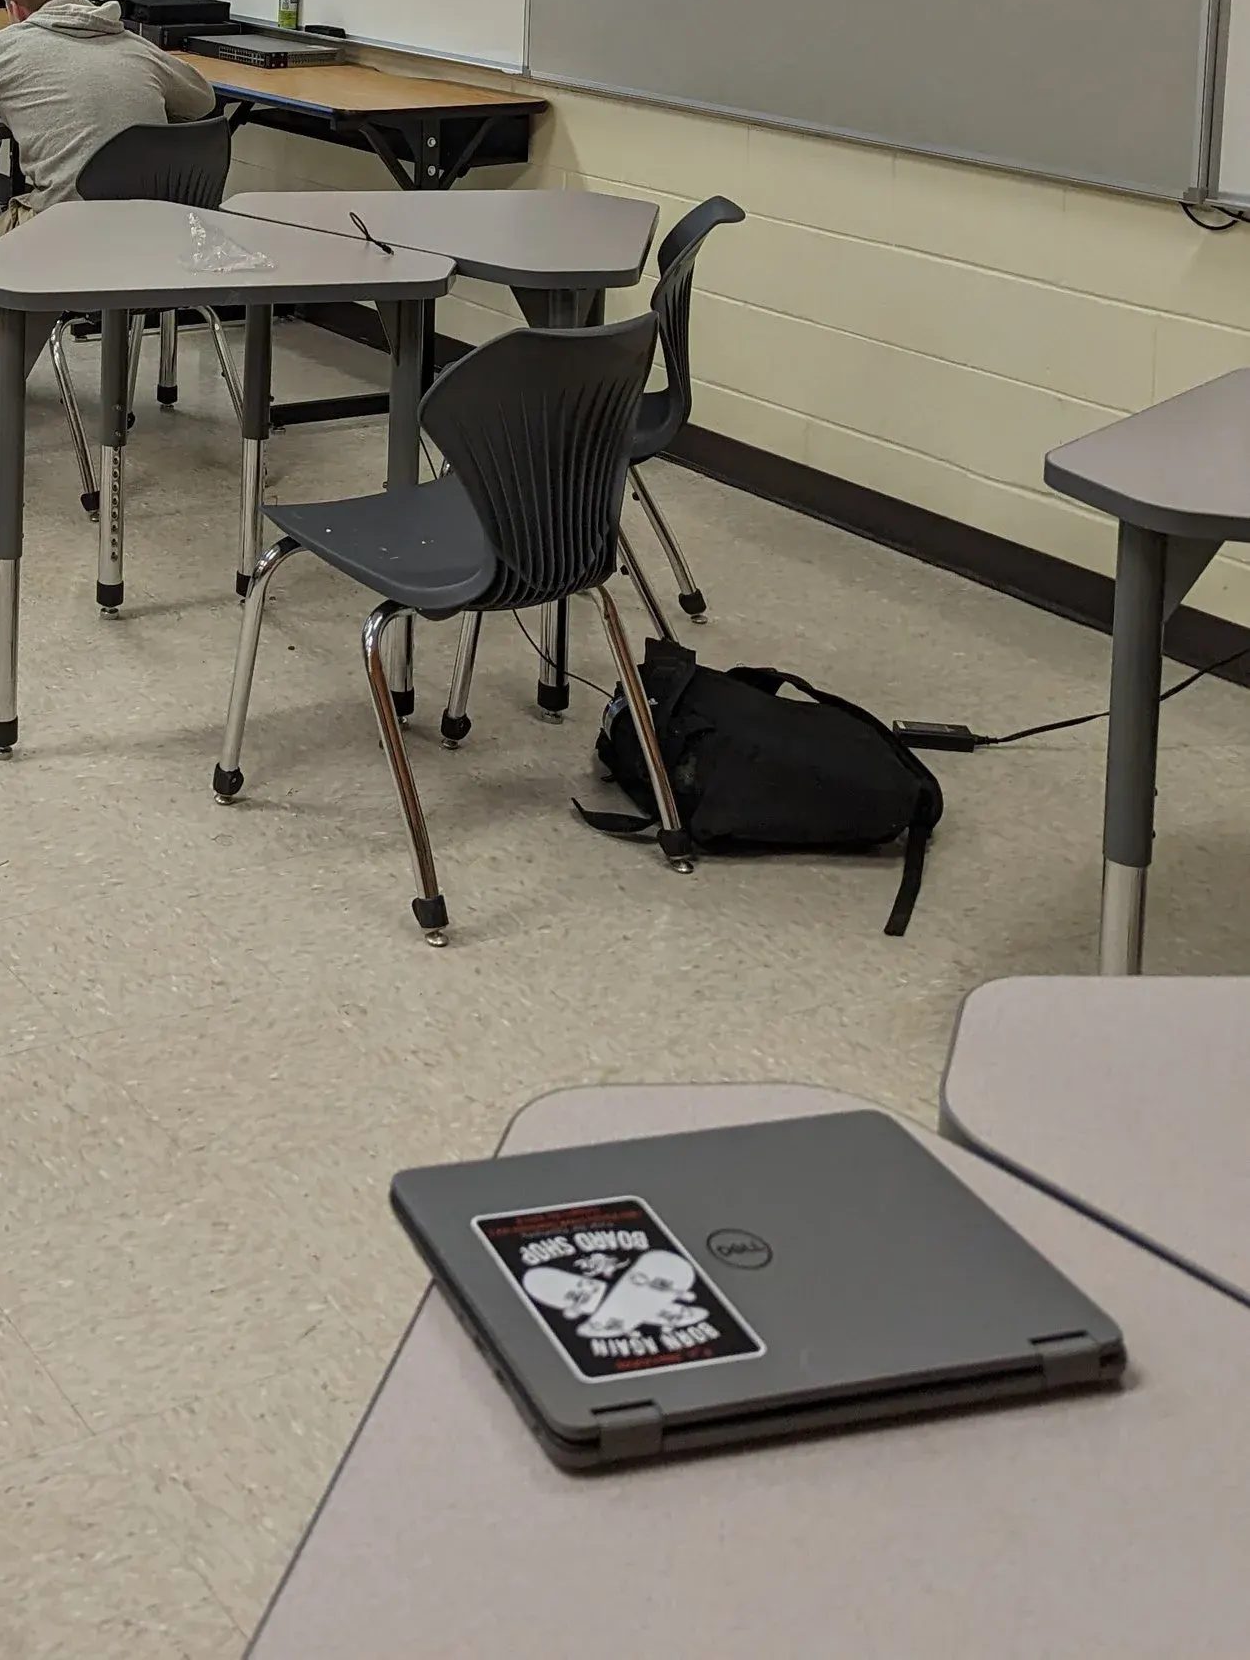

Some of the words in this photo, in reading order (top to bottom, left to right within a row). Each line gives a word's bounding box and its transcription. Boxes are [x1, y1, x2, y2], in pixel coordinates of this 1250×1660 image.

[519, 1234, 576, 1266] SHOP
[578, 1229, 649, 1252] BOARD
[715, 1242, 766, 1258] DELL
[589, 1334, 659, 1358] AGAIN
[660, 1322, 721, 1350] BORN
